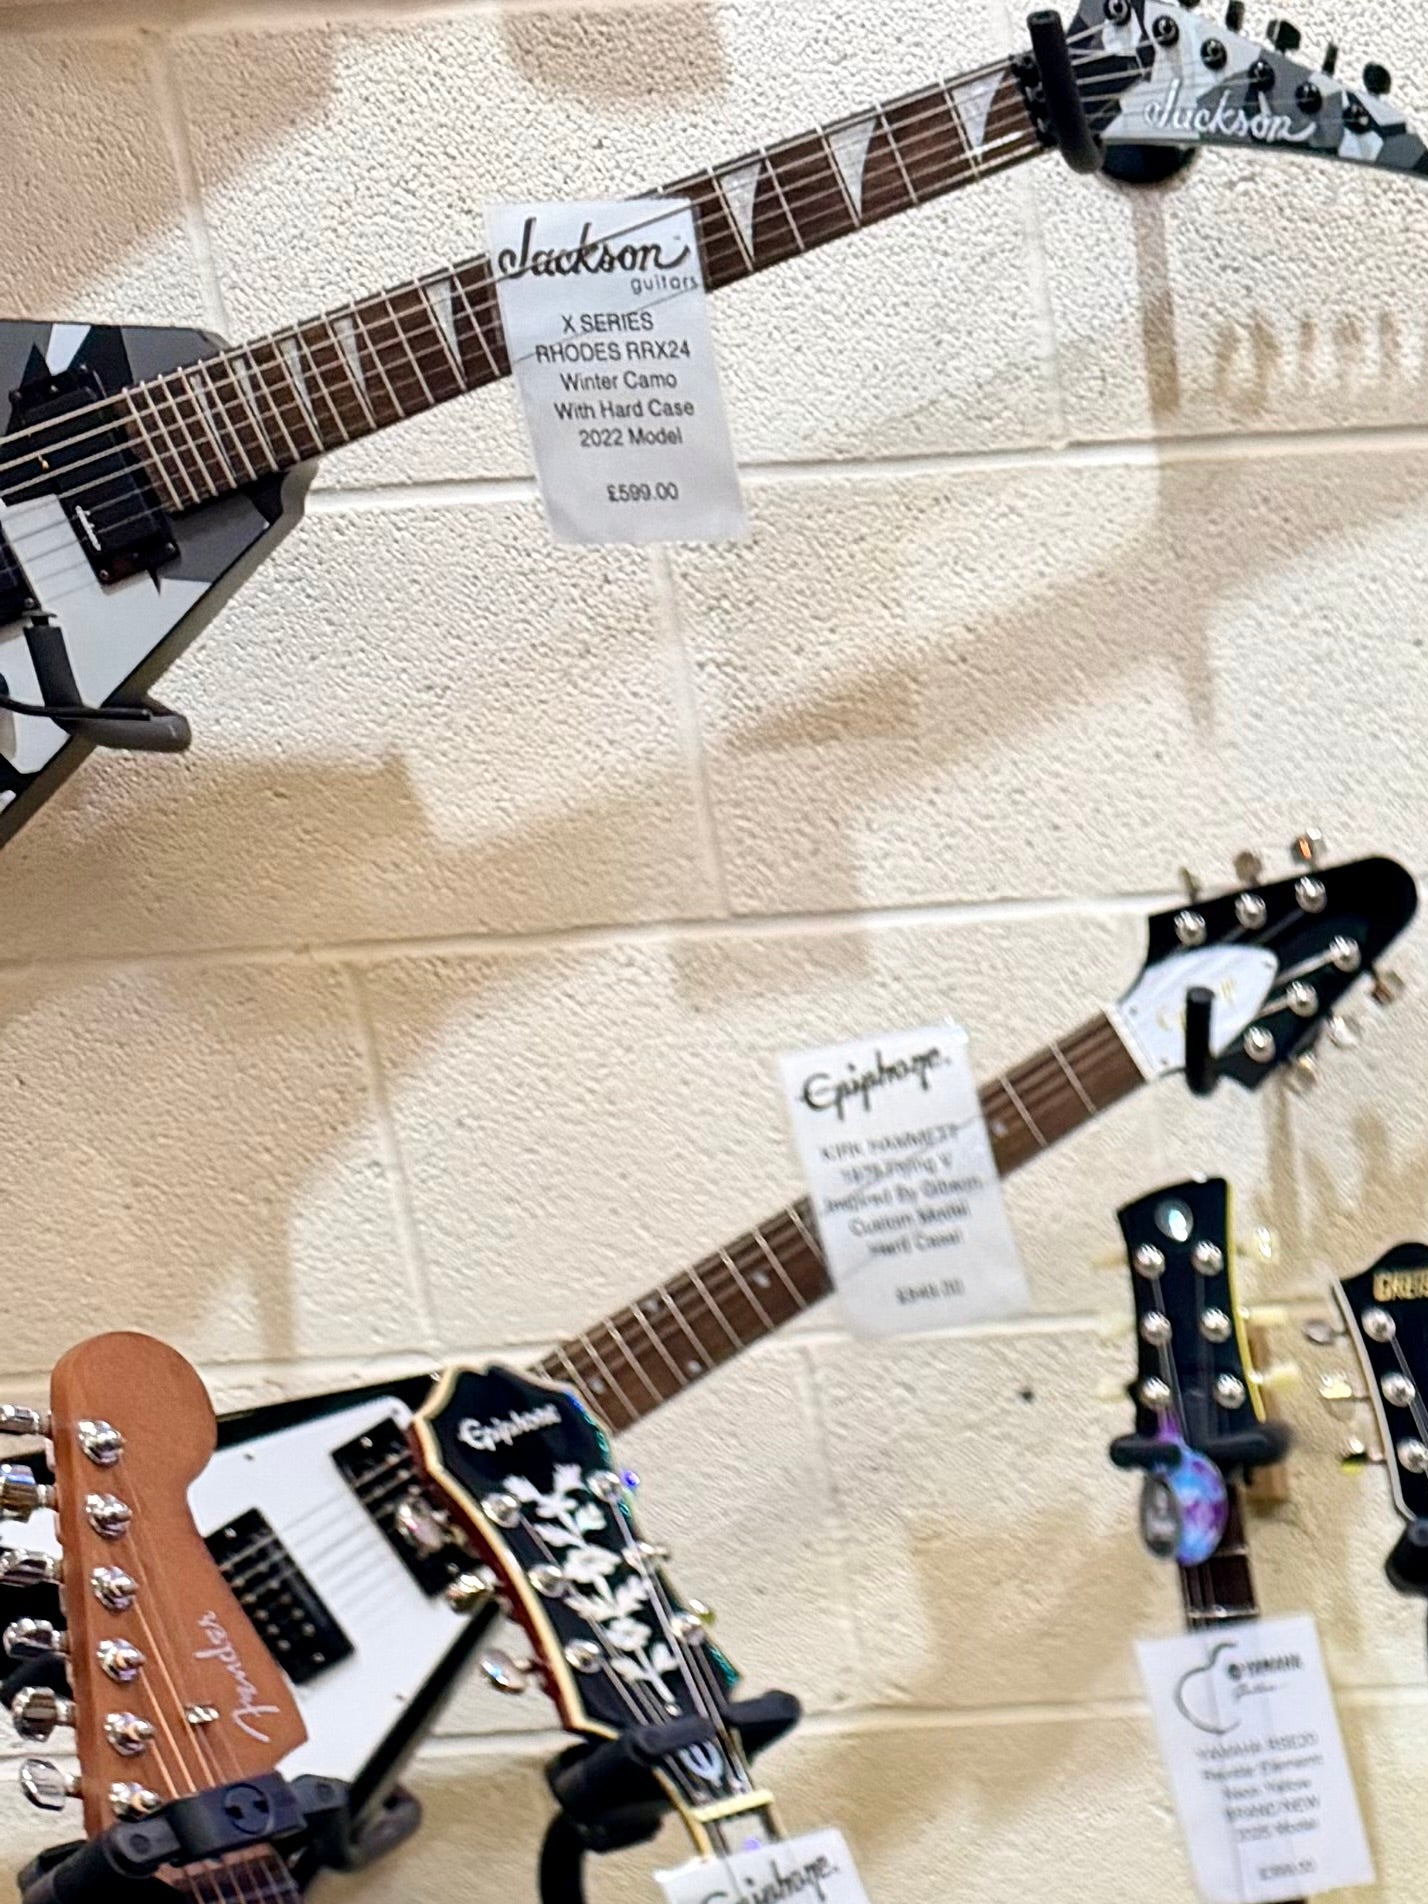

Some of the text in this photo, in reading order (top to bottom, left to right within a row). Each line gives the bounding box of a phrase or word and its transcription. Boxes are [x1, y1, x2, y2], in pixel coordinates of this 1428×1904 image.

[1144, 77, 1316, 142] Jackson
[496, 217, 692, 280] Jackson
[630, 274, 700, 295] guitars
[561, 312, 654, 333] X SERIES
[535, 340, 691, 364] RHODES RRX24
[561, 370, 678, 392] Winter Camo
[554, 398, 695, 421] With Hard Case
[579, 426, 683, 448] 2022 Model
[195, 1609, 281, 1745] Fender
